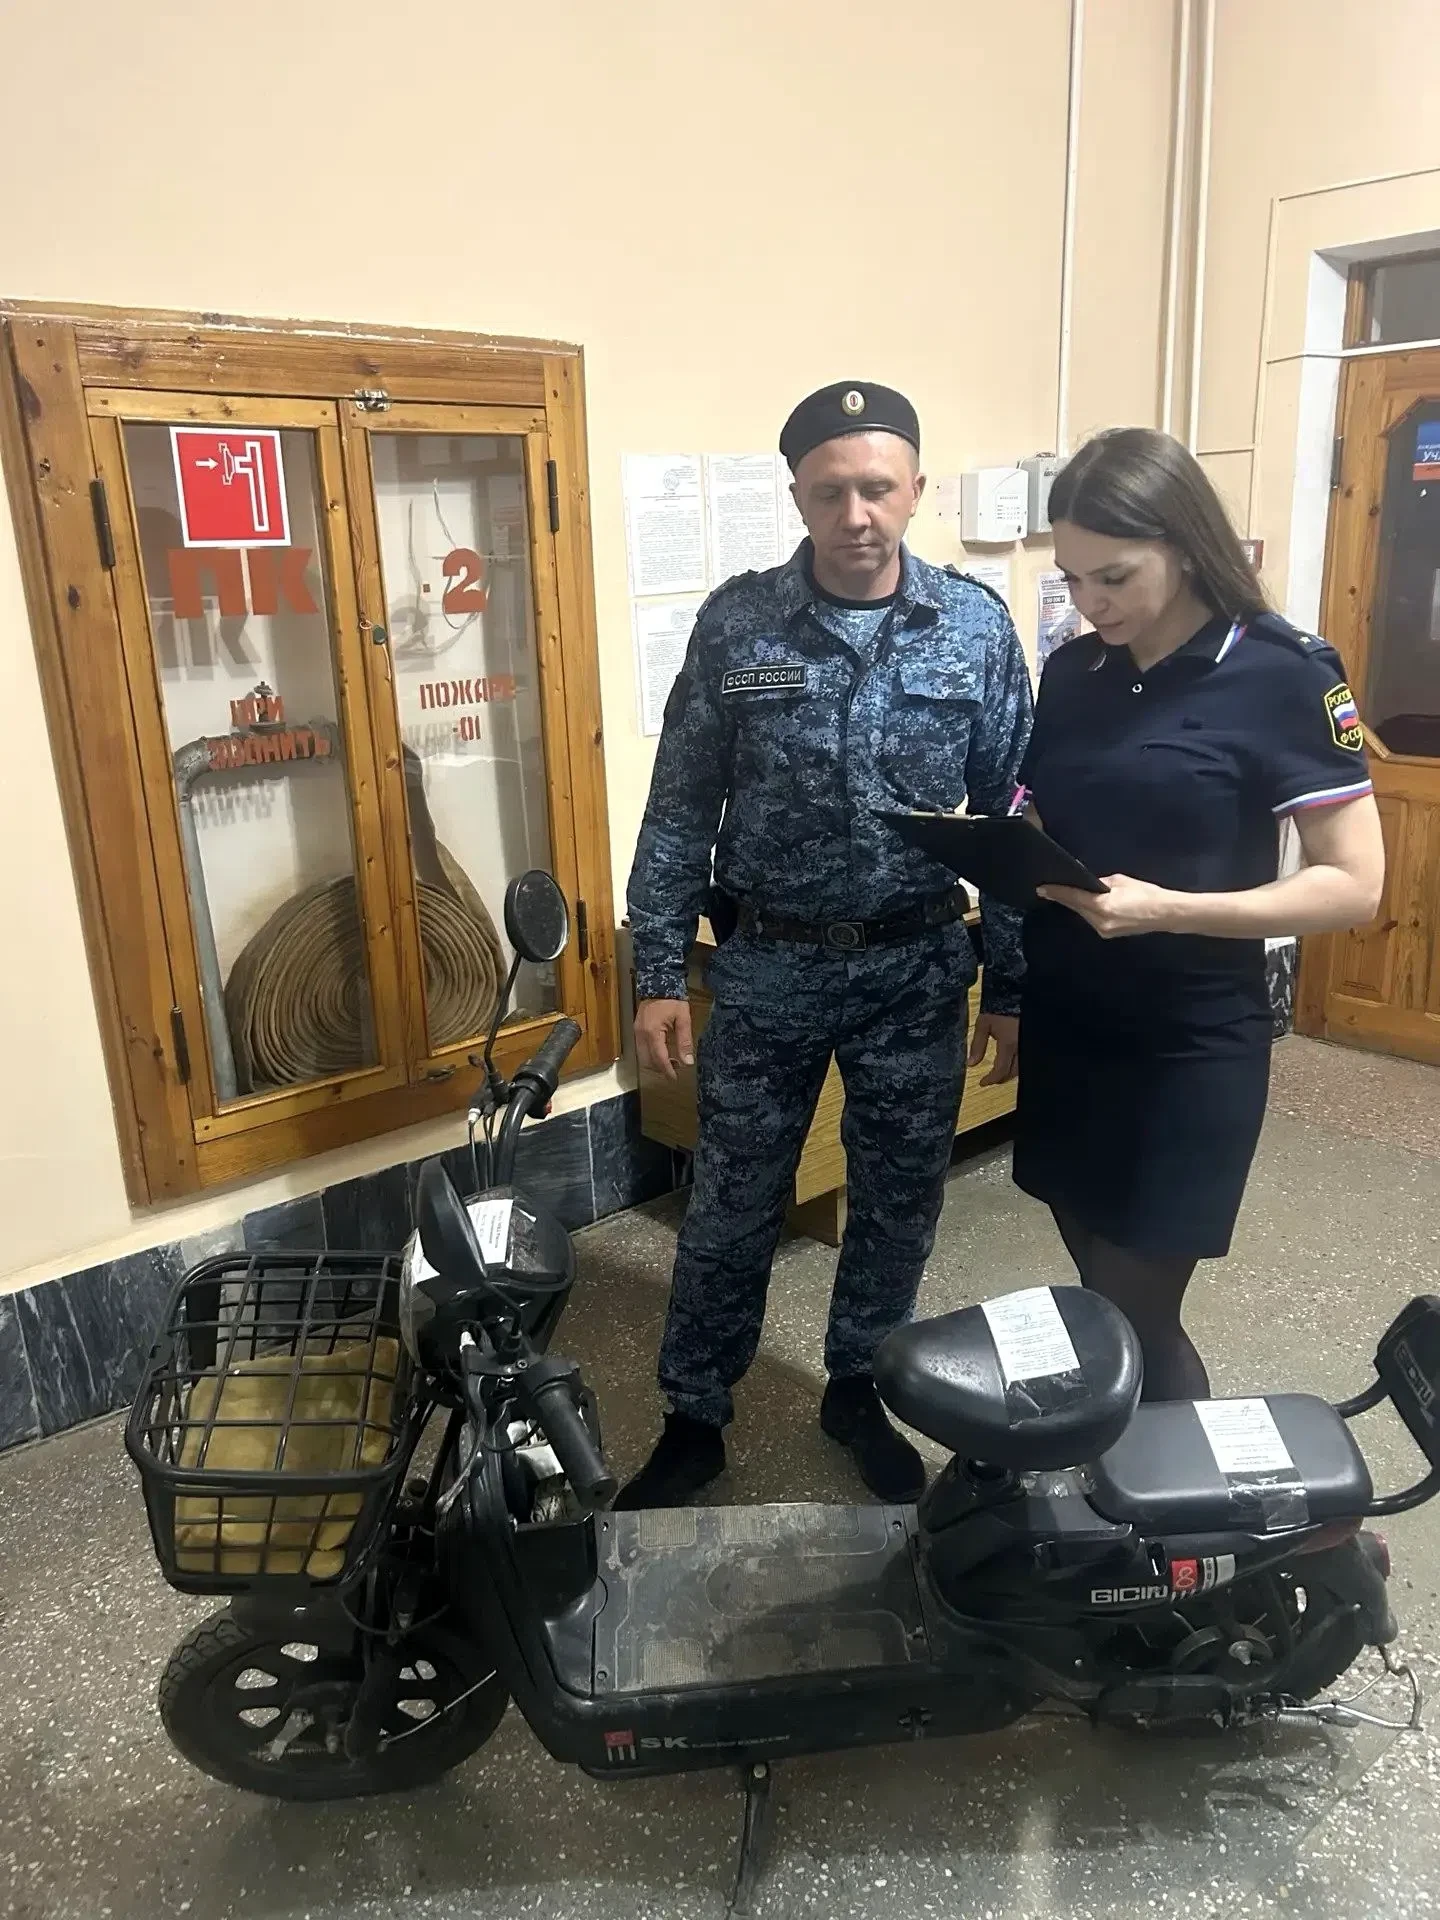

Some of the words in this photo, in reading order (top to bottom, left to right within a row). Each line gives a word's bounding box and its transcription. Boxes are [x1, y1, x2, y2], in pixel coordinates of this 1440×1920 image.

[168, 548, 319, 619] ПК
[726, 672, 755, 686] ФССП
[759, 670, 801, 684] РОССИИ
[640, 1736, 689, 1749] SK
